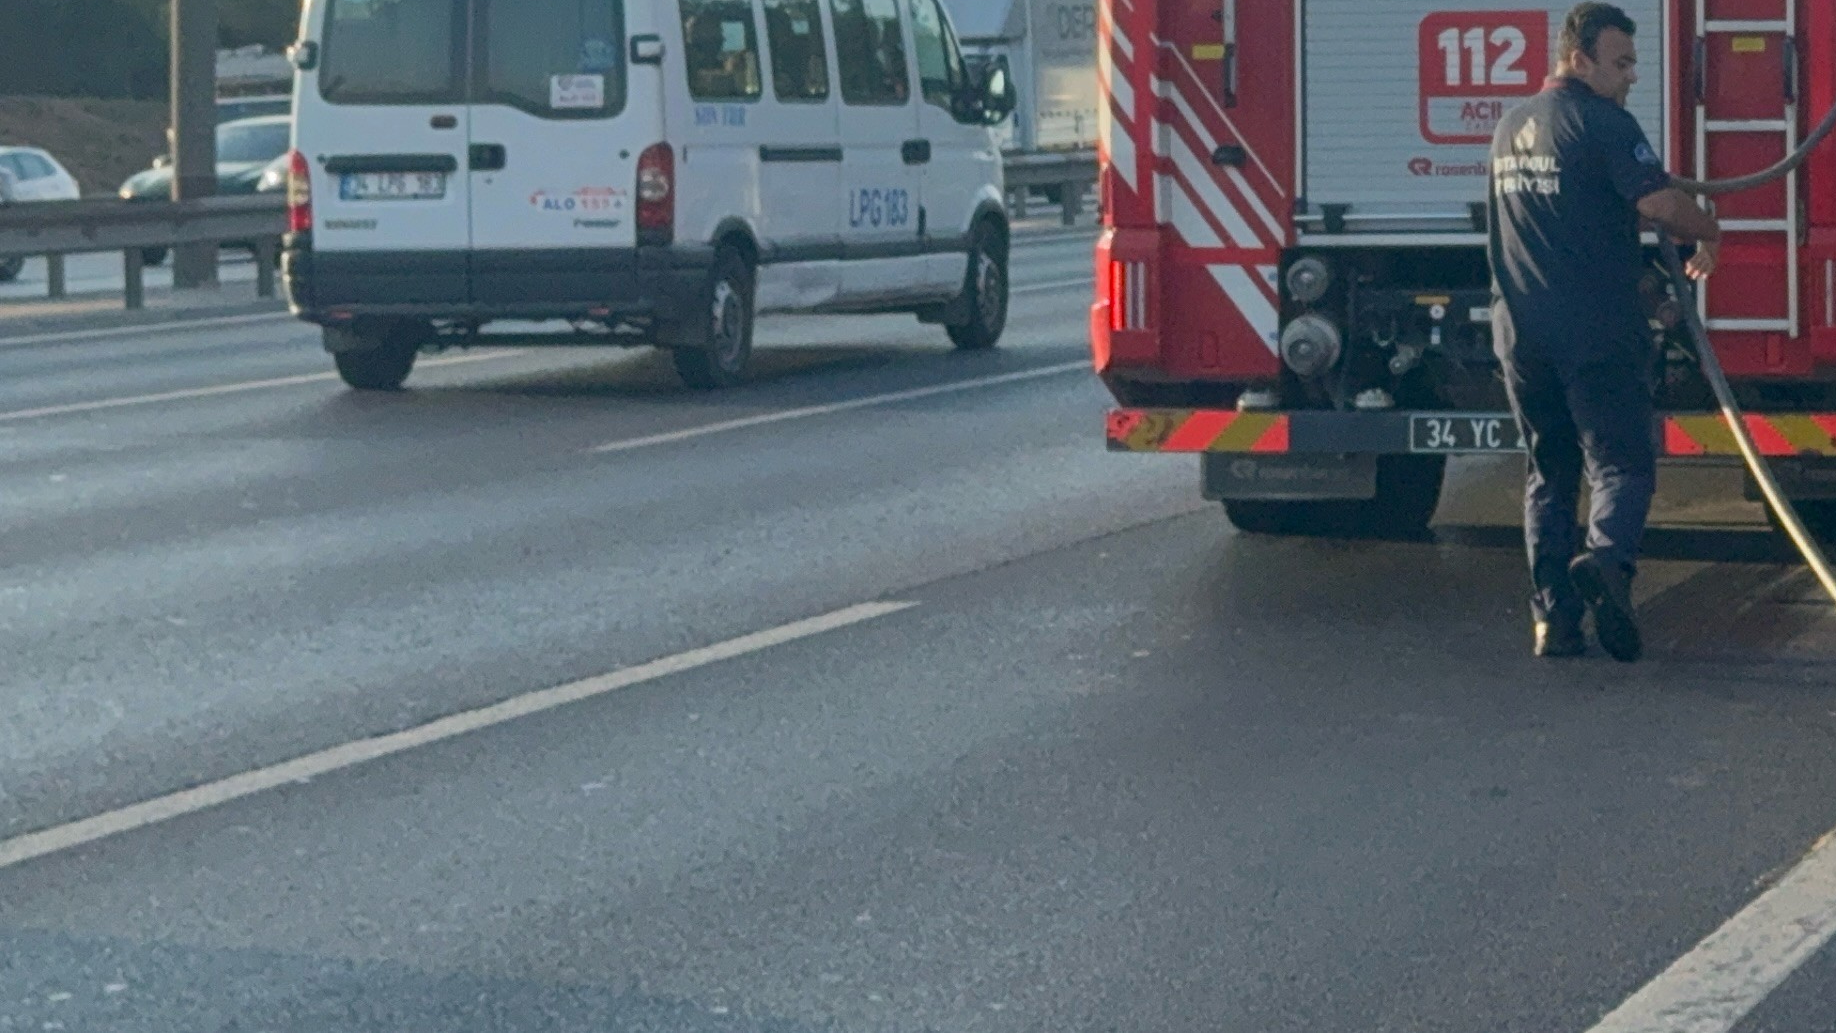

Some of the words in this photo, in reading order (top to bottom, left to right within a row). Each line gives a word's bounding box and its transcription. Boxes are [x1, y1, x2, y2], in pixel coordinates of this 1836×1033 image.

[1437, 25, 1528, 86] 112
[1435, 160, 1487, 176] rosenb
[1426, 419, 1456, 447] 34
[1470, 419, 1501, 447] YC
